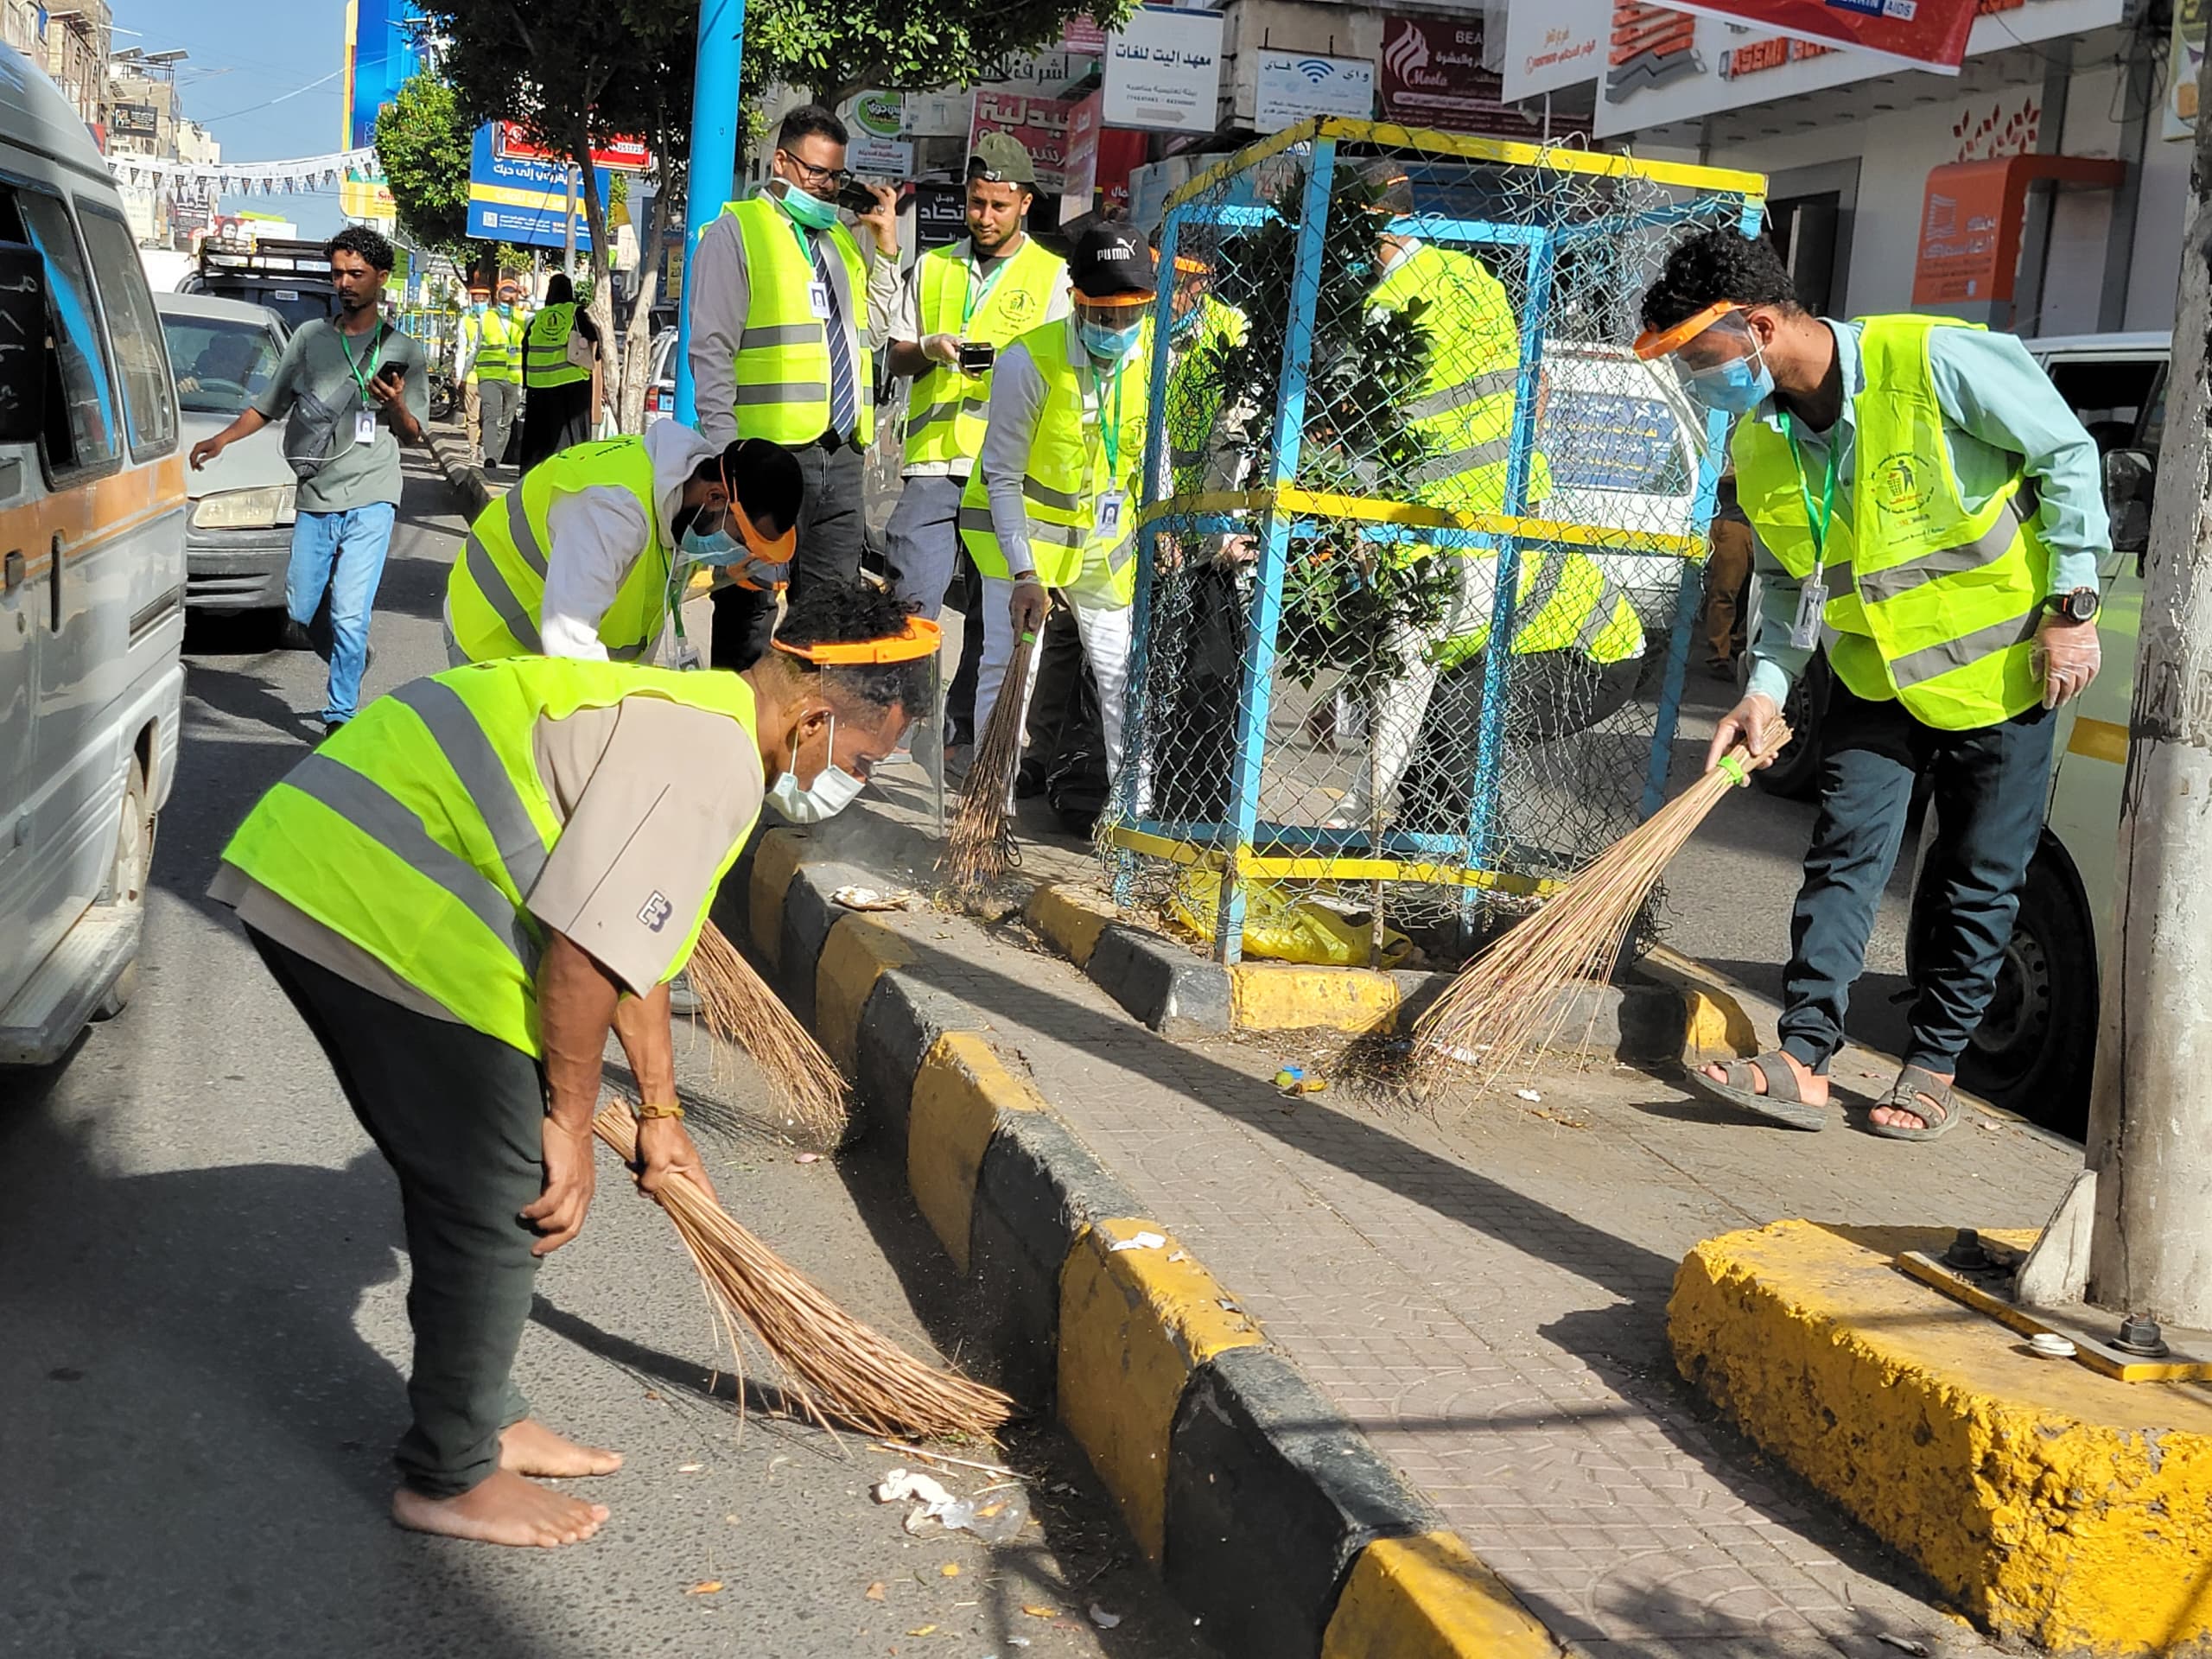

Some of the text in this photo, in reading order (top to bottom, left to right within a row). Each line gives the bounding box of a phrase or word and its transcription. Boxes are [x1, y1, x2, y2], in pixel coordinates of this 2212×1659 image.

[1115, 44, 1212, 69] معهد إليت للغات
[980, 96, 1069, 137] يدلية
[1096, 248, 1130, 262] PUMA
